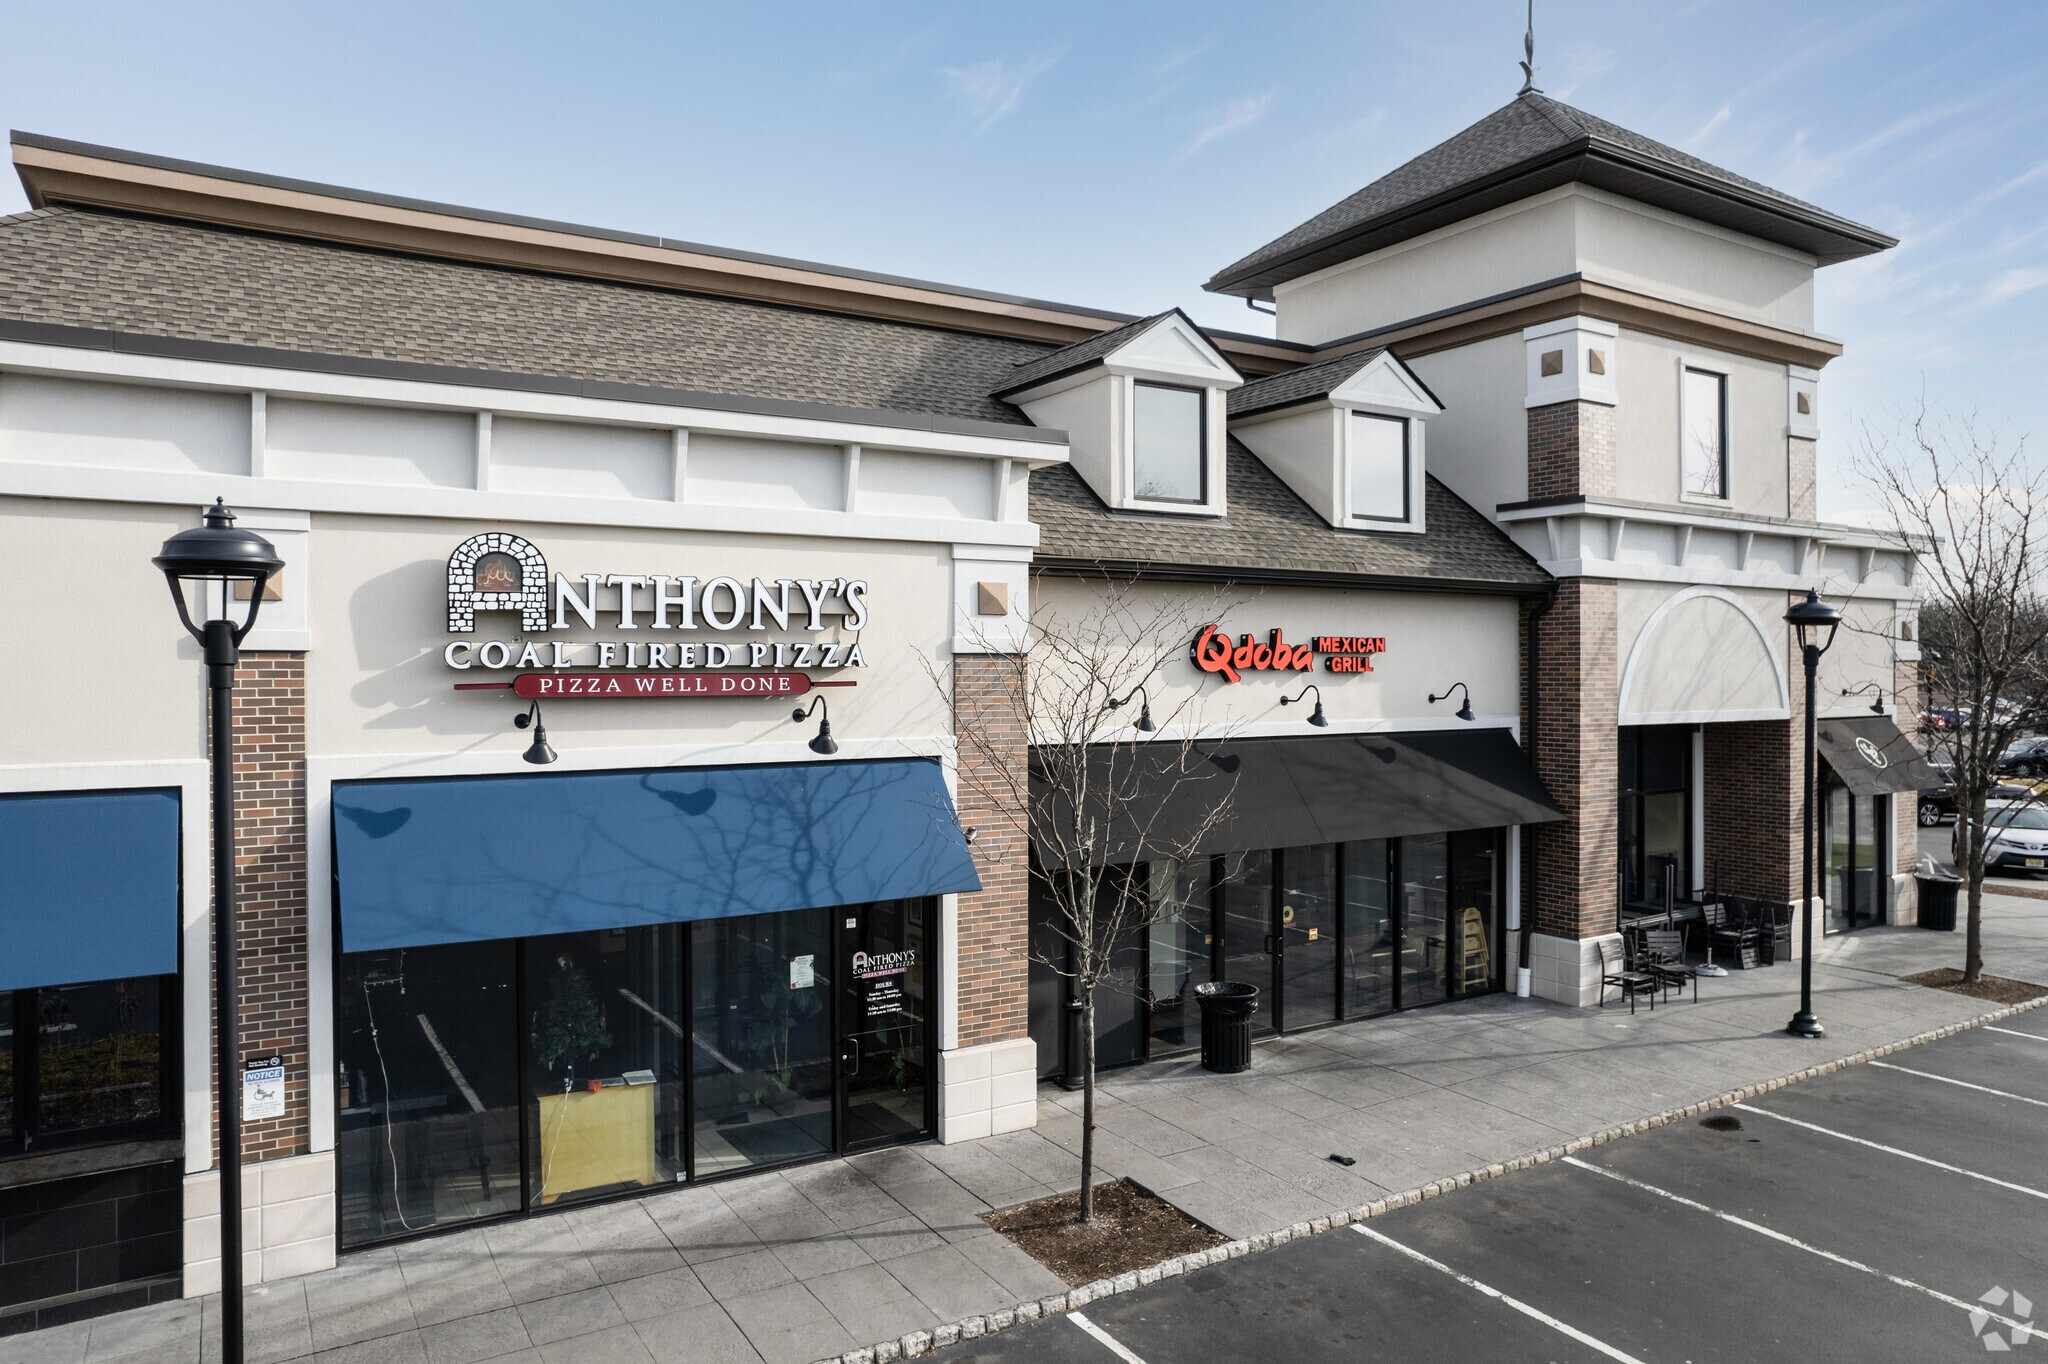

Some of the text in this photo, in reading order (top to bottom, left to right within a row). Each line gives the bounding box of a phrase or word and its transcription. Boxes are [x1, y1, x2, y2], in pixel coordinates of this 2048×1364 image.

[447, 532, 868, 633] ANTHONY'S
[1191, 624, 1314, 682] Qdoba
[1317, 636, 1386, 653] MEXICAN
[443, 640, 868, 670] COAL FIRED PIZZA
[1330, 656, 1374, 672] GRILL
[539, 676, 791, 694] PIZZA WELL DONE
[853, 950, 915, 969] ANTHONY'S
[853, 960, 915, 975] COAL FIRED PIZZA
[247, 1070, 281, 1081] NOTICE
